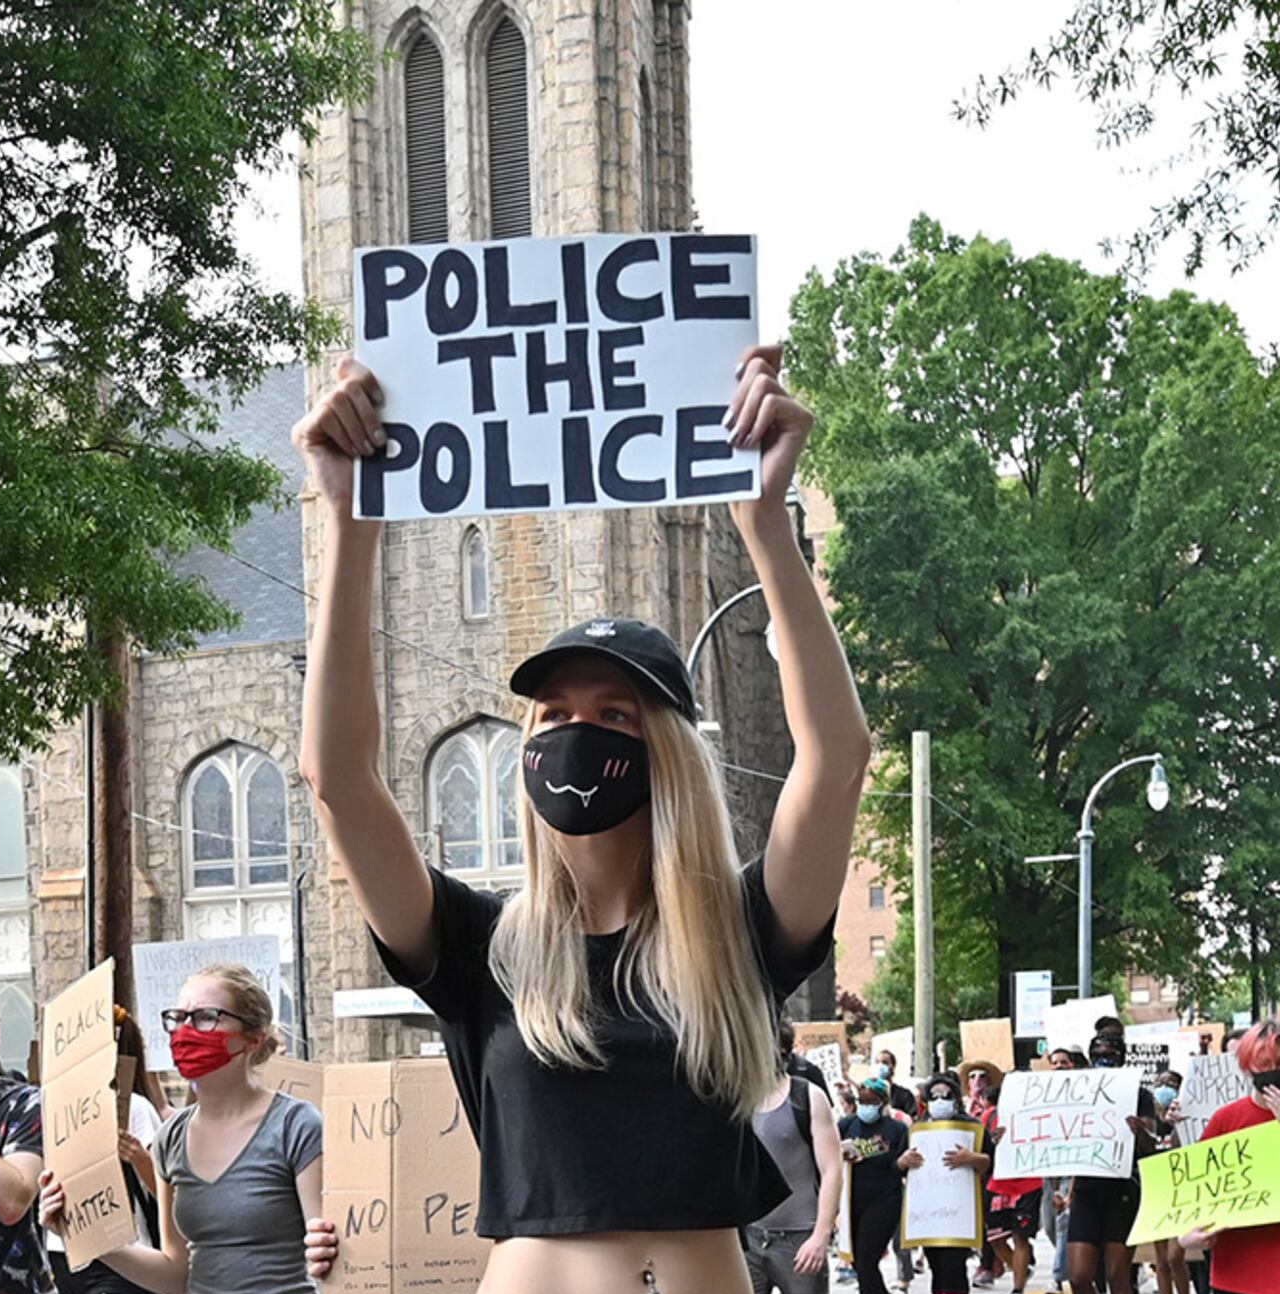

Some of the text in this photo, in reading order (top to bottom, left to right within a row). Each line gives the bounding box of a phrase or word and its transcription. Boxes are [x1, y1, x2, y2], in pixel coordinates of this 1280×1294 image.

[361, 235, 752, 340] POLICE
[437, 325, 646, 415] THE
[360, 405, 754, 517] POLICE
[54, 999, 107, 1056] BLACK
[1023, 1073, 1116, 1106] BLACK
[1186, 1072, 1253, 1106] SUPREM
[53, 1090, 101, 1147] LIVES
[351, 1096, 402, 1143] NO
[1010, 1110, 1117, 1144] LIVES
[1014, 1141, 1125, 1172] MATTER!!
[1169, 1138, 1253, 1187] BLACK
[1154, 1190, 1271, 1230] MATTER
[1171, 1166, 1253, 1208] LIVES
[63, 1186, 120, 1239] MATTER
[345, 1198, 387, 1239] NO
